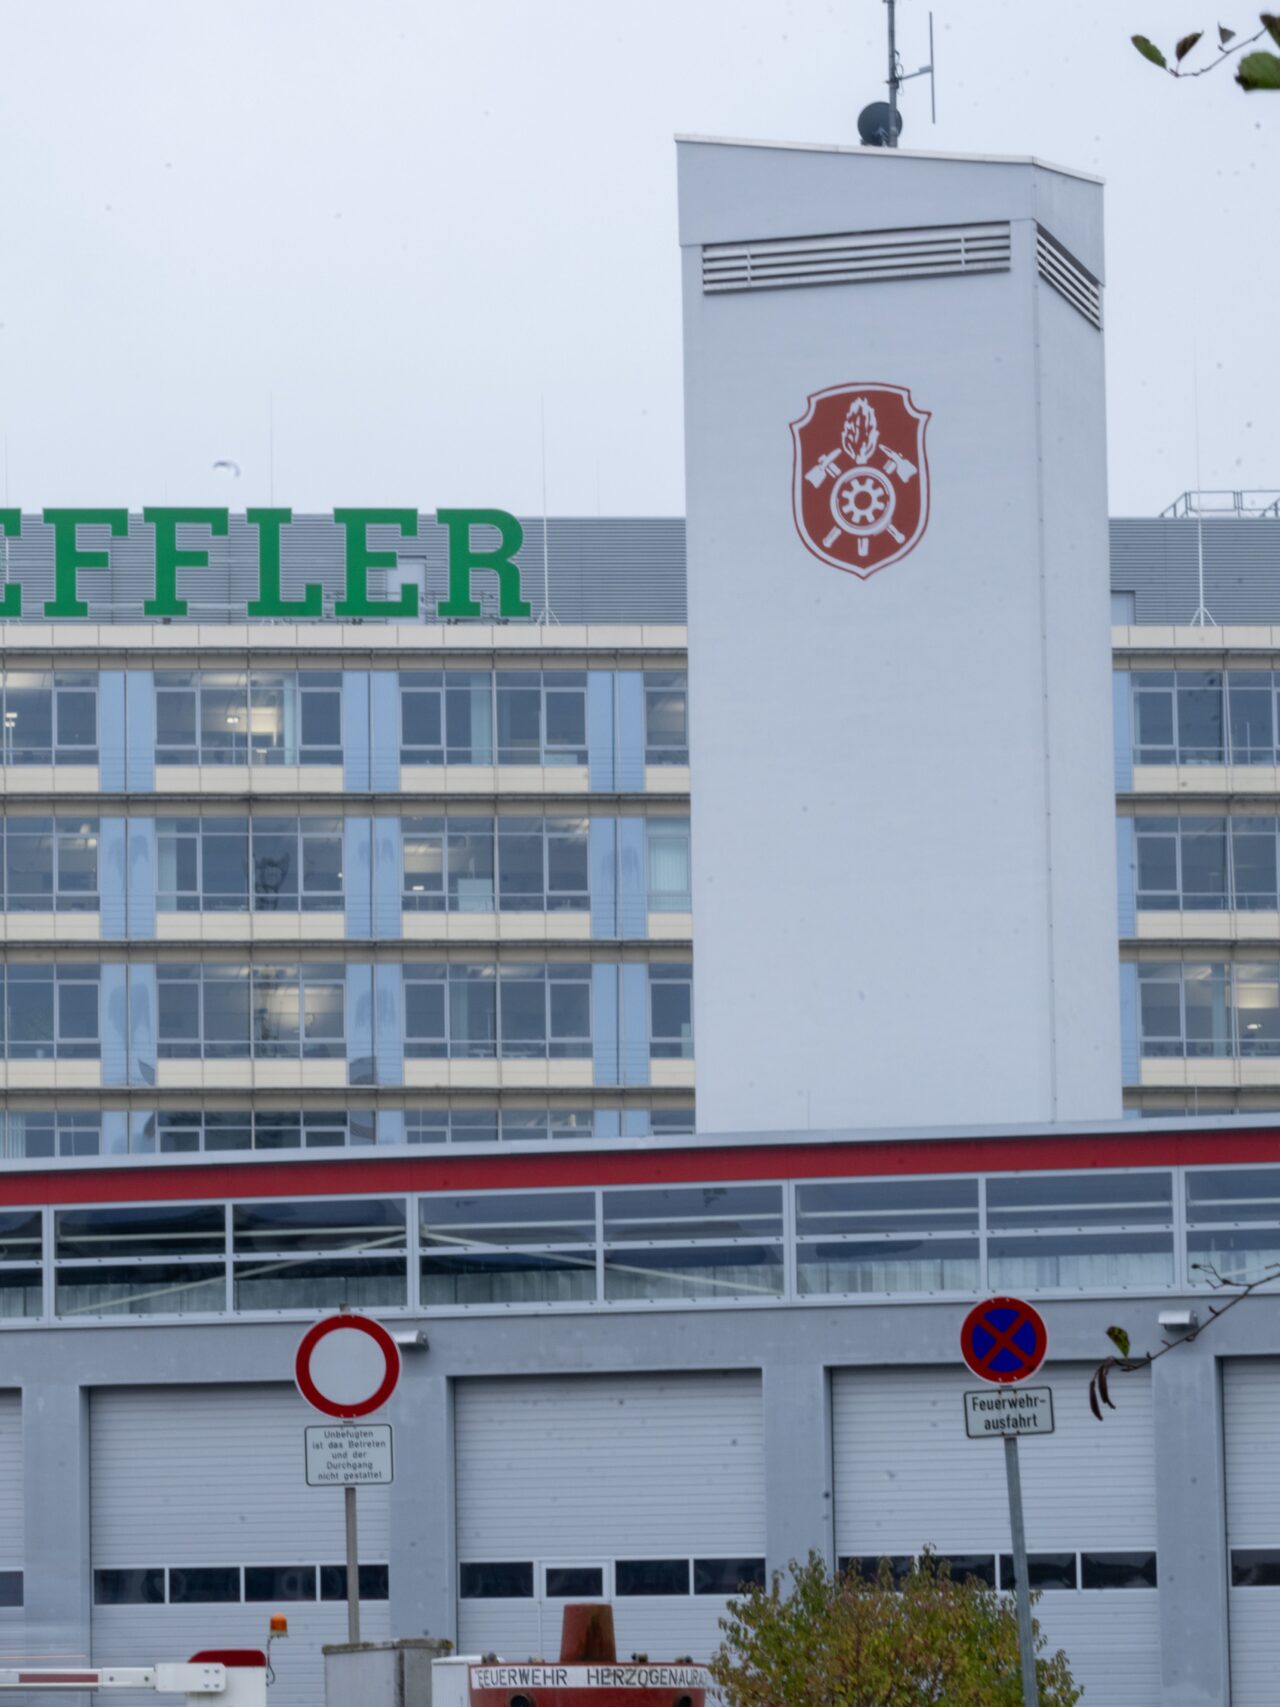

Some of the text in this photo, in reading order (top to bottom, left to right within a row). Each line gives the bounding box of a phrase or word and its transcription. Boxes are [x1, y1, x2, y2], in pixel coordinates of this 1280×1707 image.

[972, 1394, 1046, 1411] Feuerwehr-
[984, 1413, 1038, 1430] ausfahrt
[324, 1430, 373, 1438] Unbefugten
[328, 1441, 343, 1449] das
[348, 1439, 386, 1448] Betreten
[332, 1450, 367, 1459] und der
[326, 1461, 373, 1470] Durchgang
[344, 1471, 382, 1480] gestattet
